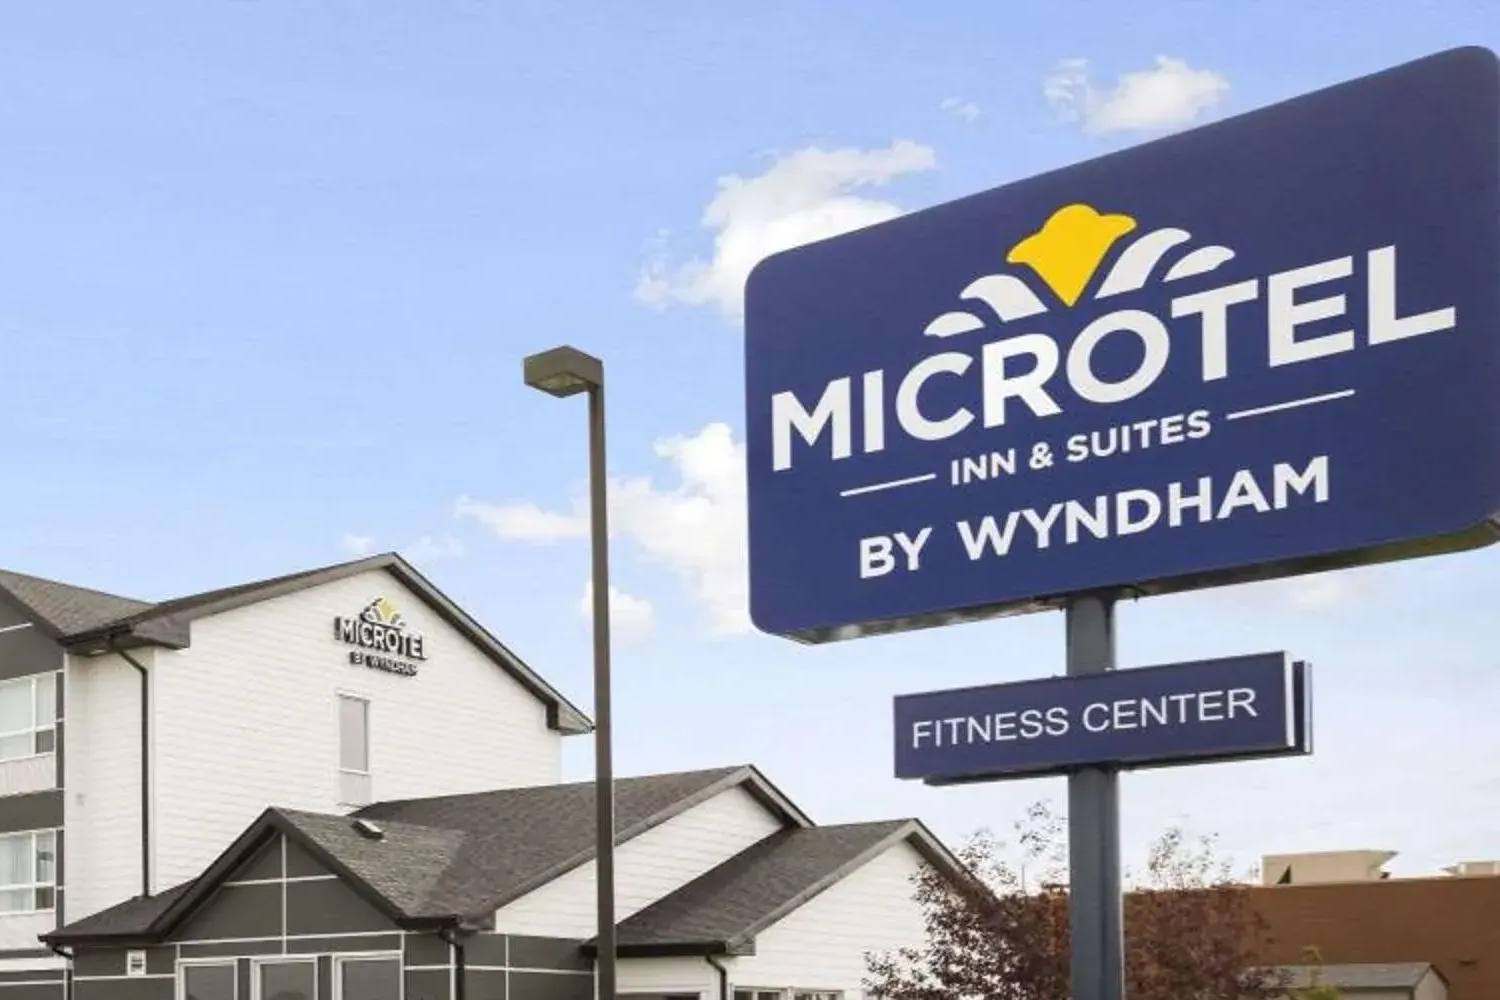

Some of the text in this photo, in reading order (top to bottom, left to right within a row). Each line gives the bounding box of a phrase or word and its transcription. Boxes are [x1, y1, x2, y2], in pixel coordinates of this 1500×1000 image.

[772, 245, 1455, 471] MICROTEL
[951, 410, 1211, 486] INN & SUITES
[860, 456, 1329, 578] BY WYNDHAM
[336, 616, 428, 660] MICROTEL
[912, 688, 1258, 748] FITNESS CENTER
